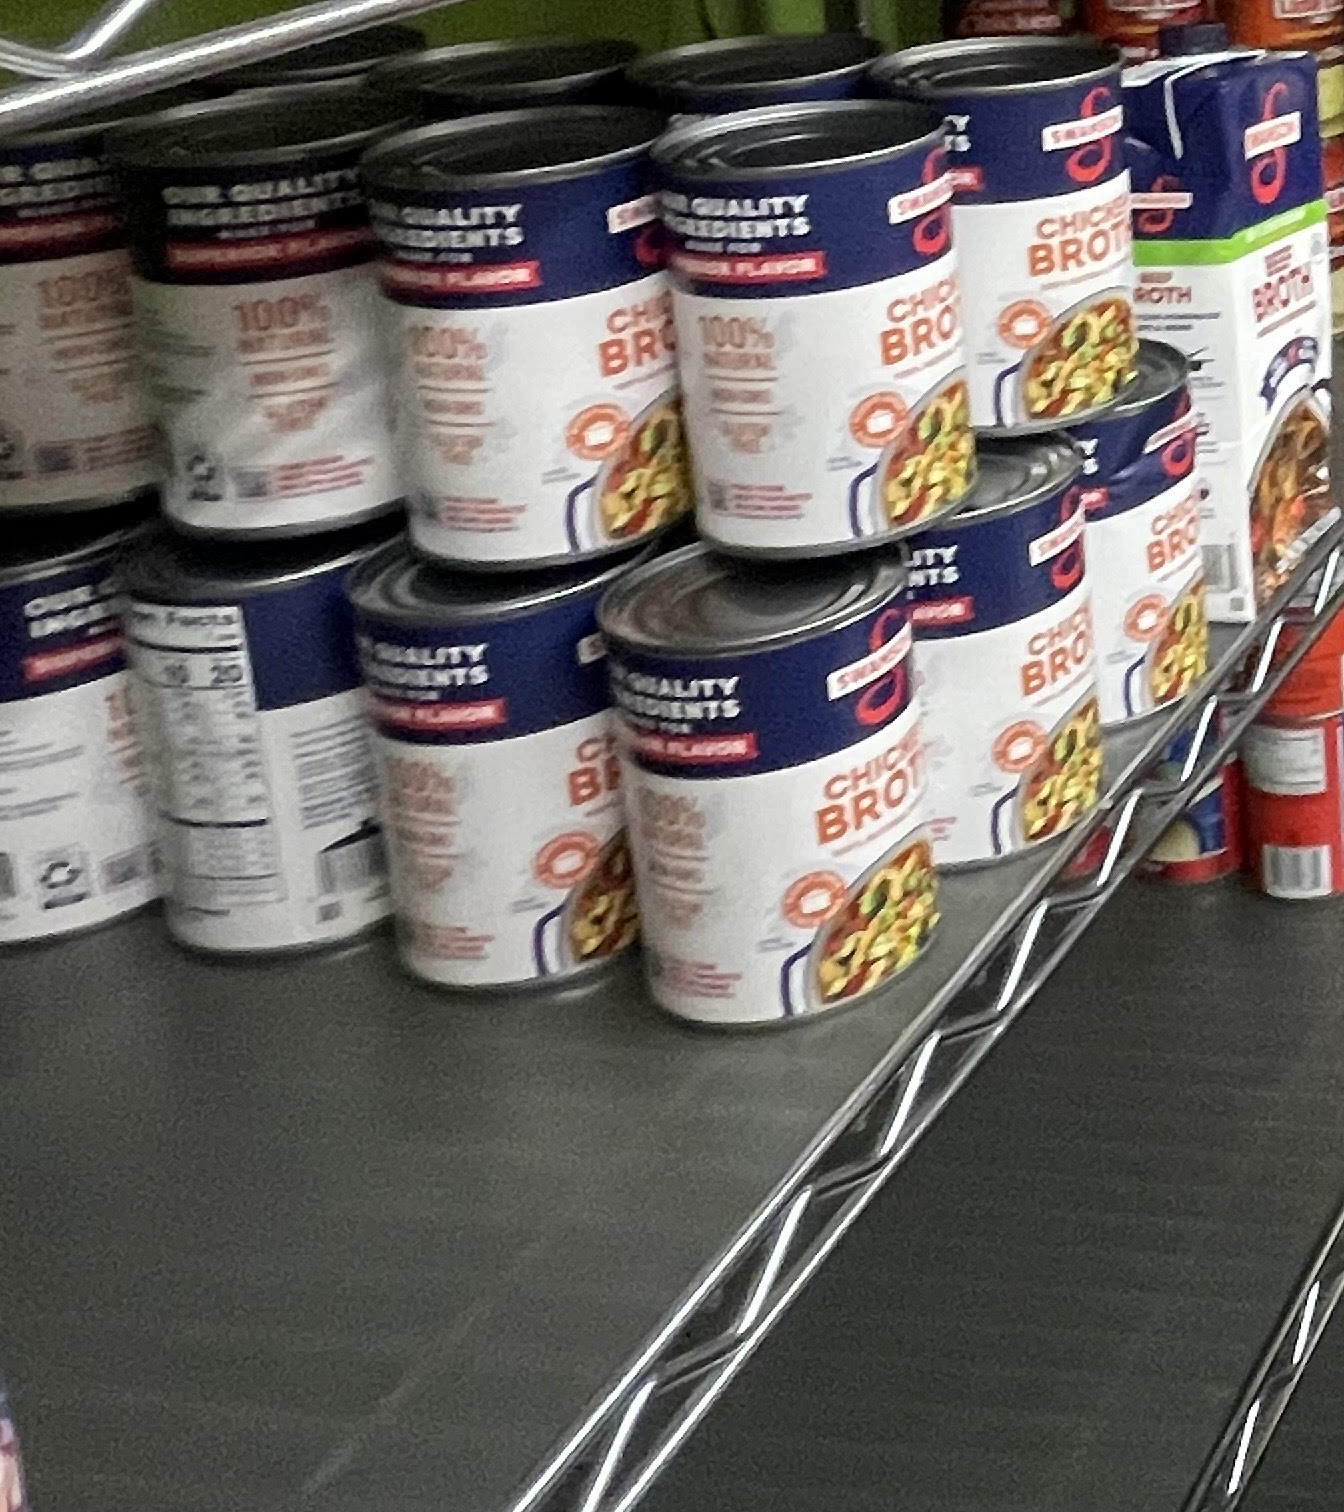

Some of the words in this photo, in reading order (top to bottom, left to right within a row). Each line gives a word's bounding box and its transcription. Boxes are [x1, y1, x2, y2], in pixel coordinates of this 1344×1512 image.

[691, 193, 810, 219] QUALITY
[1026, 220, 1131, 277] BROT
[1133, 285, 1193, 305] ROTH
[880, 304, 959, 367] BRO
[1020, 631, 1093, 696] BRO
[814, 748, 926, 846] BROT
